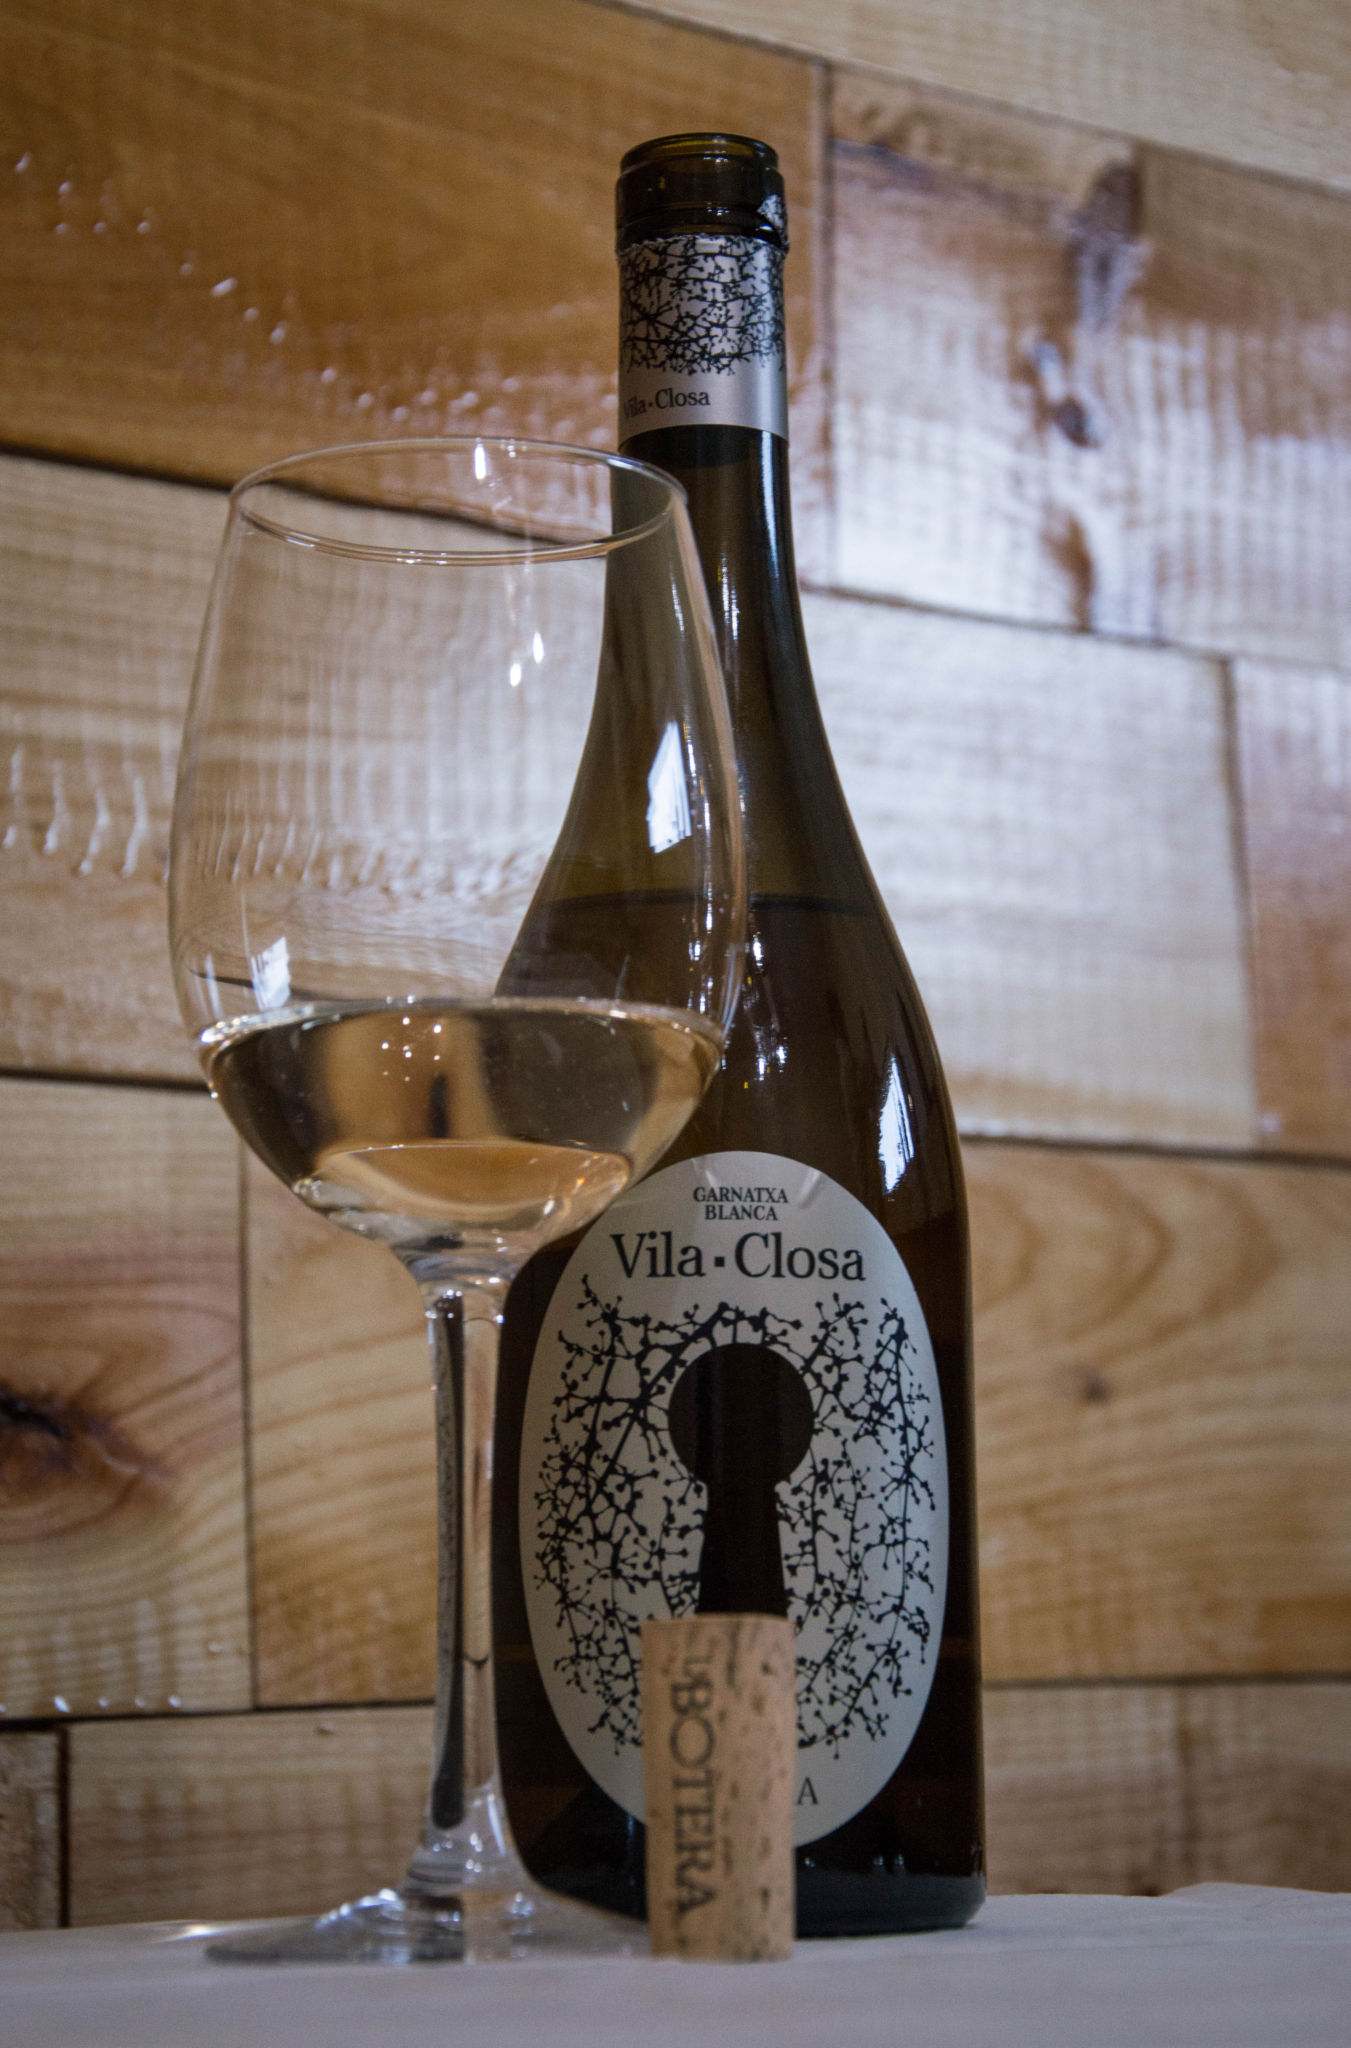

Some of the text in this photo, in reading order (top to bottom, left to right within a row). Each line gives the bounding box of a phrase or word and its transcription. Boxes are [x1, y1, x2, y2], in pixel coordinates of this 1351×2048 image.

[655, 387, 711, 409] Closa
[692, 1186, 789, 1204] GARNATXA
[704, 1204, 778, 1221] BLANCA
[609, 1230, 866, 1281] Vila Closa
